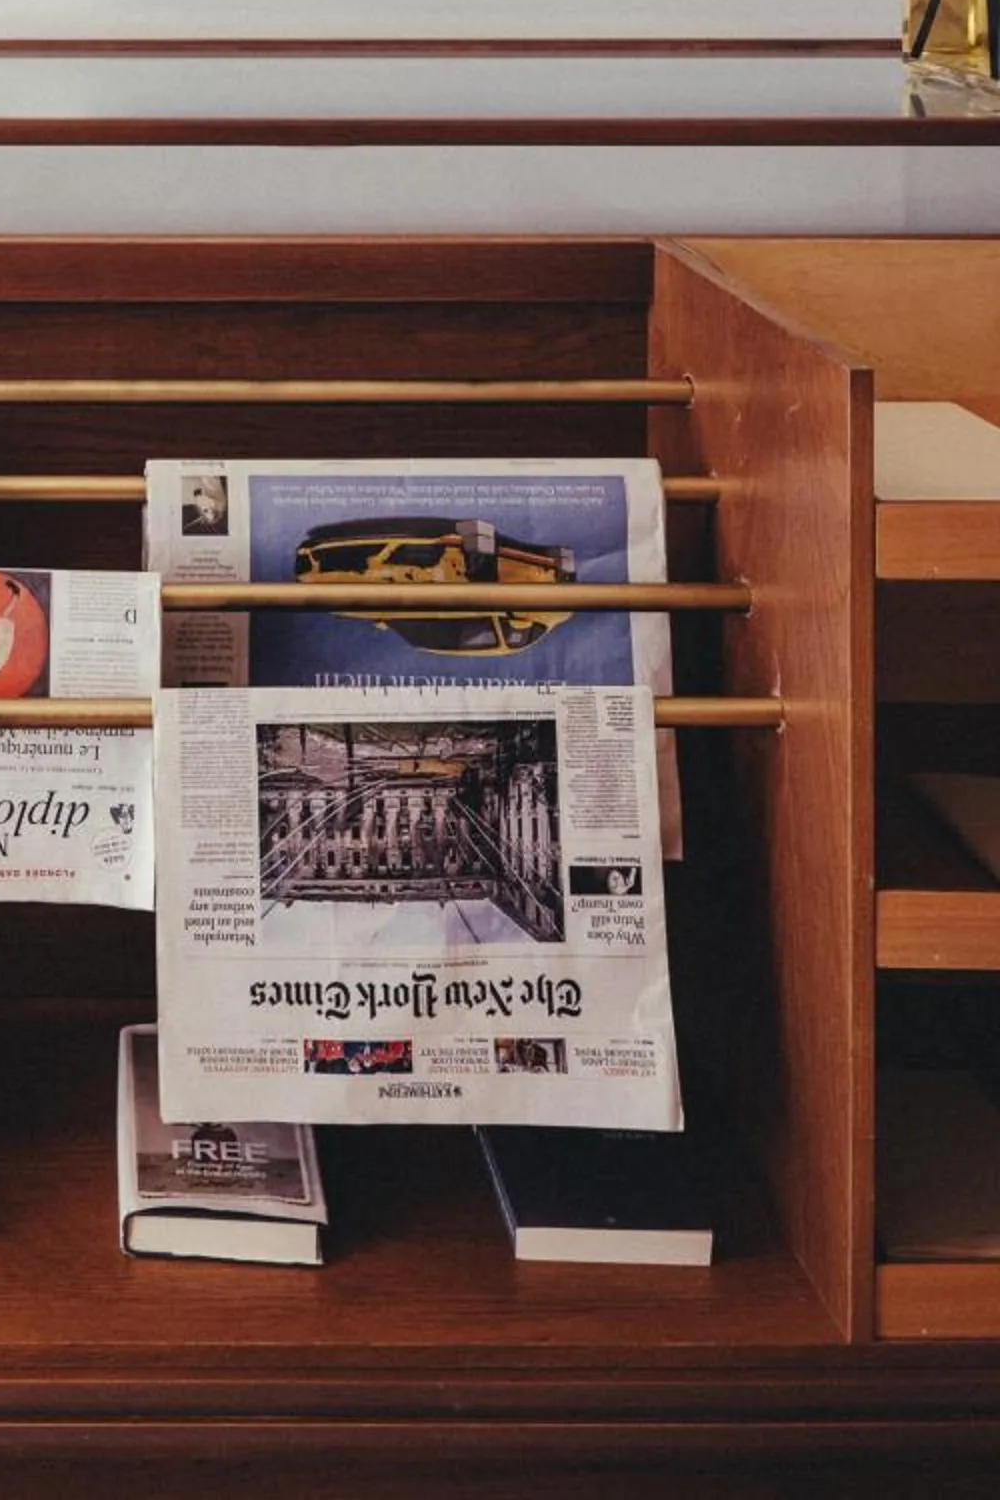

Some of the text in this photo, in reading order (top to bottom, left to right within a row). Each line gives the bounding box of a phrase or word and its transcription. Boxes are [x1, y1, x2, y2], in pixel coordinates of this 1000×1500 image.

[80, 745, 99, 760] Le
[194, 888, 255, 900] constraints
[189, 899, 255, 914] without any
[572, 898, 643, 913] own Trump?
[184, 918, 255, 930] and an Israel
[592, 915, 645, 929] Putin still
[193, 930, 255, 946] Netanyahu
[587, 931, 646, 946] Why does
[248, 972, 582, 1020] The New York Times
[172, 1139, 271, 1164] FREE
